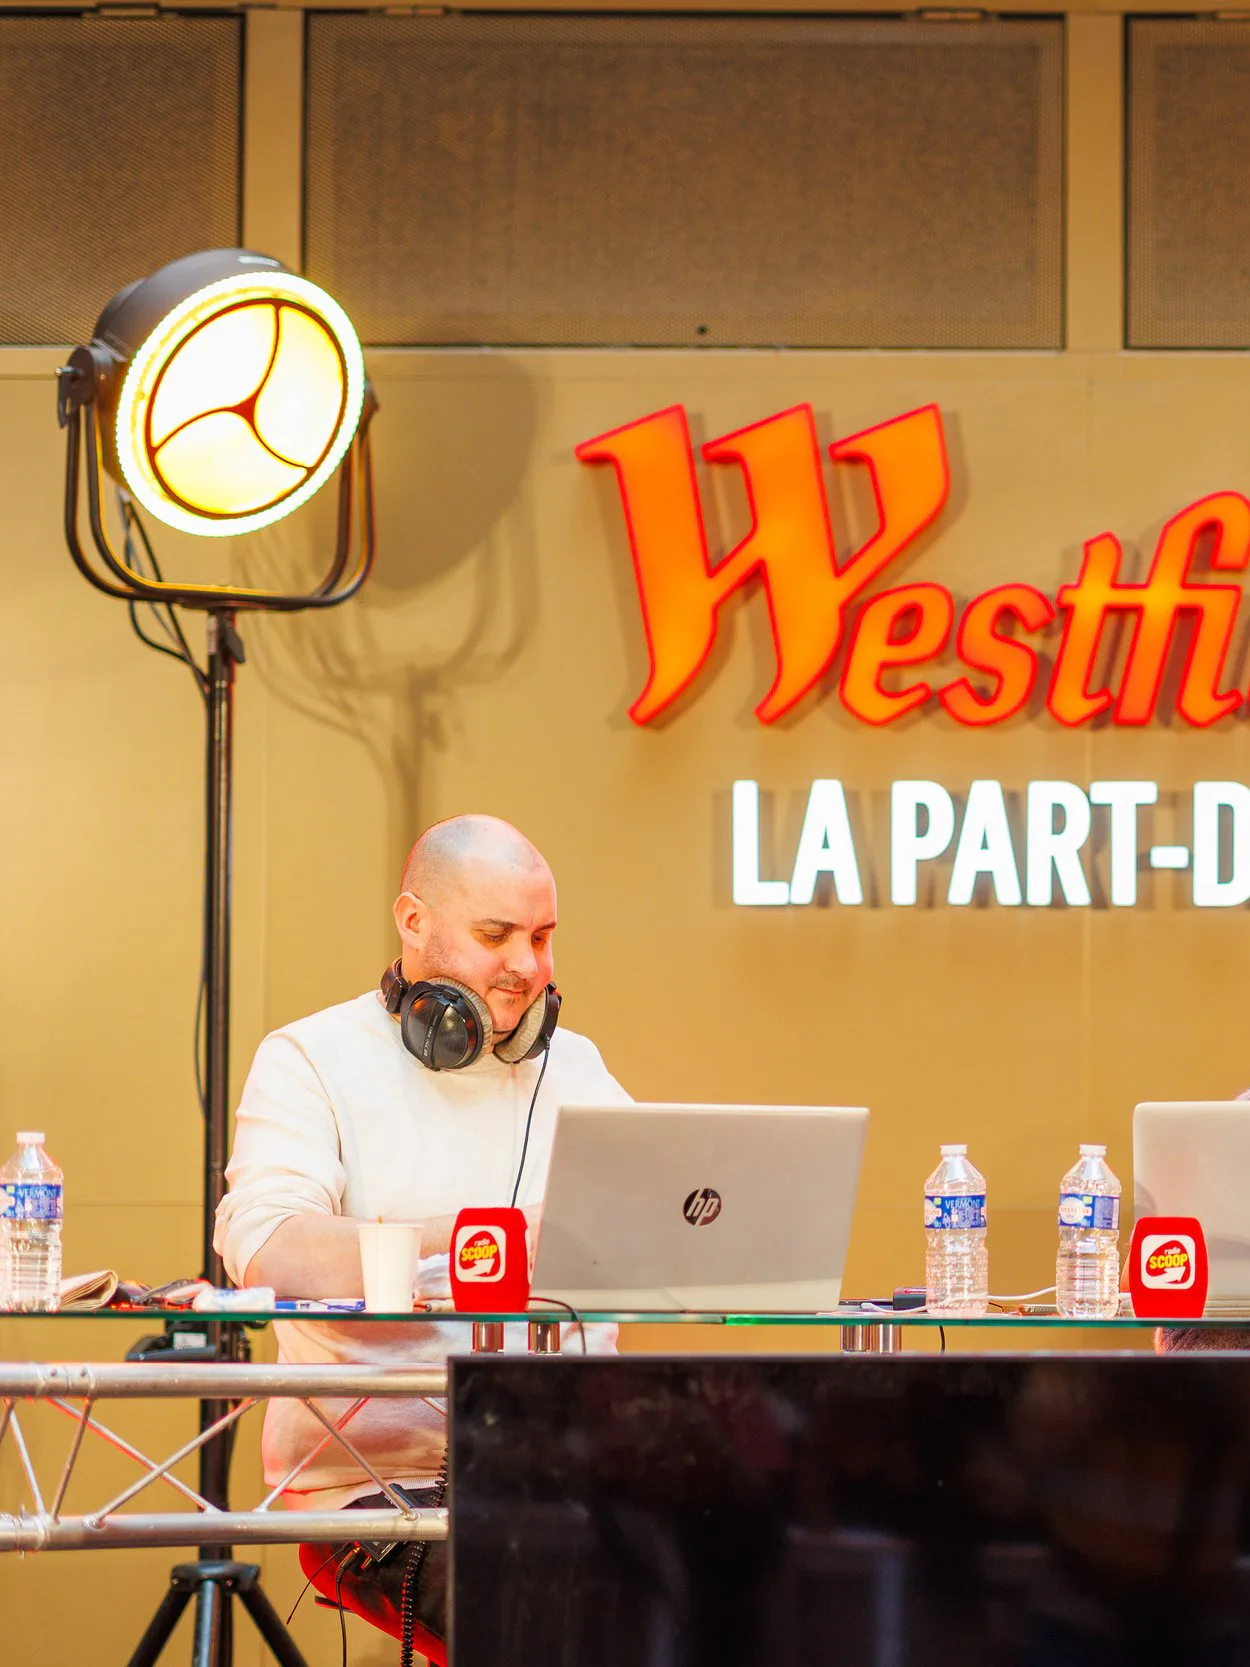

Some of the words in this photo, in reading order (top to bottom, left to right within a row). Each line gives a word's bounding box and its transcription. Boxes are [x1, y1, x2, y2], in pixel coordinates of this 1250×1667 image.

[731, 779, 864, 908] LA
[686, 1188, 719, 1228] hp
[461, 1244, 498, 1262] SCOOP
[1149, 1253, 1189, 1270] SCOOP
